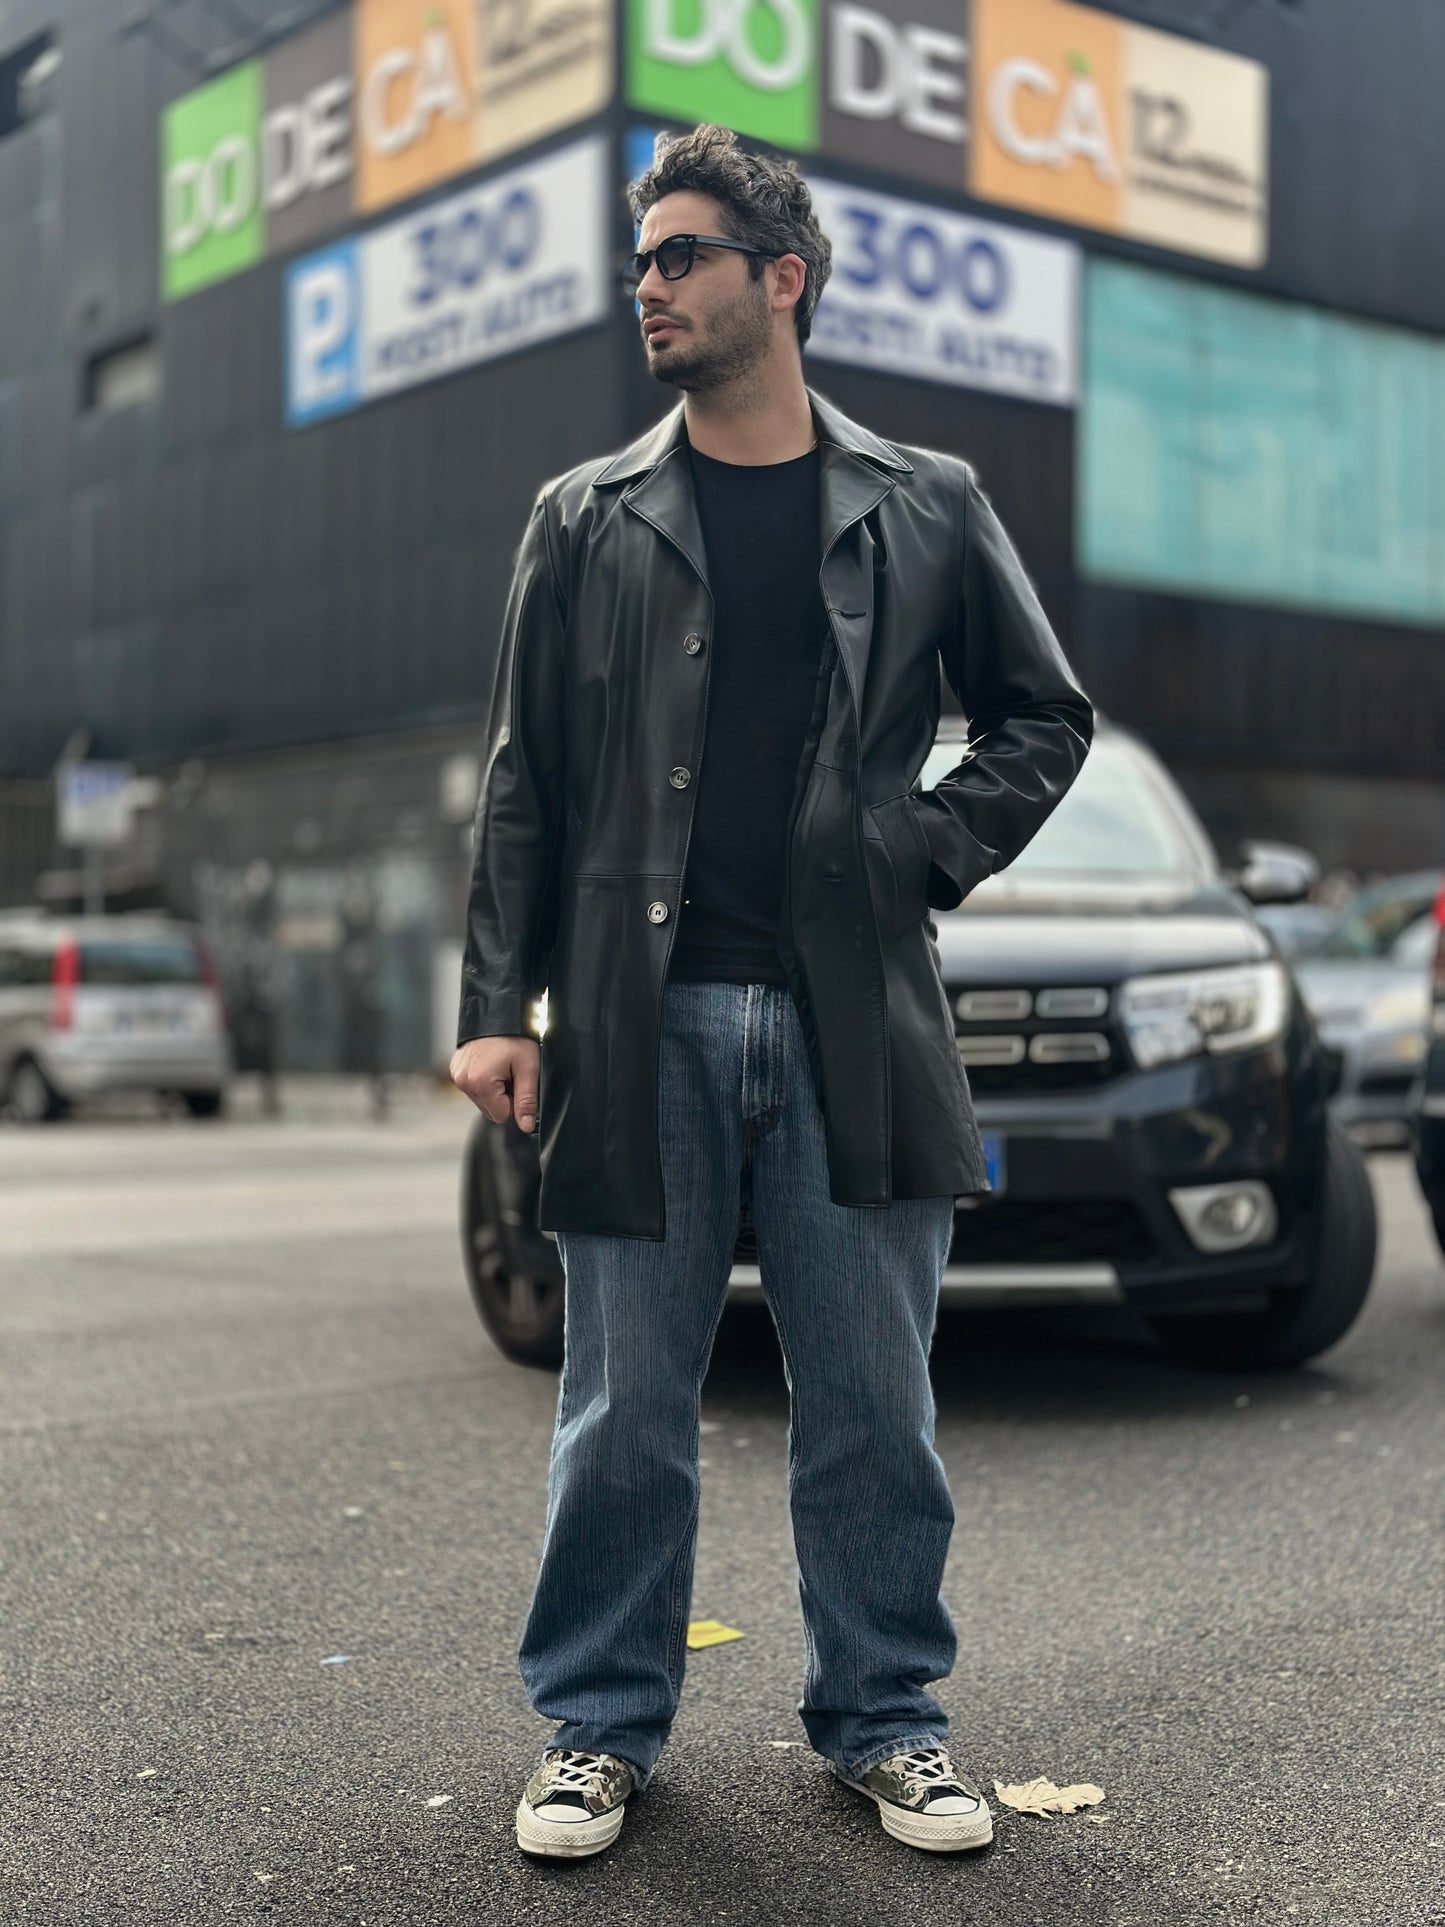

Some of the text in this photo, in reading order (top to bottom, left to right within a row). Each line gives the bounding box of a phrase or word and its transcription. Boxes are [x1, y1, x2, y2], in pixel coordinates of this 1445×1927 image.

[410, 186, 543, 307] 300
[837, 204, 1010, 318] 300
[296, 262, 352, 402] P
[812, 298, 1061, 385] OSTI AUTO
